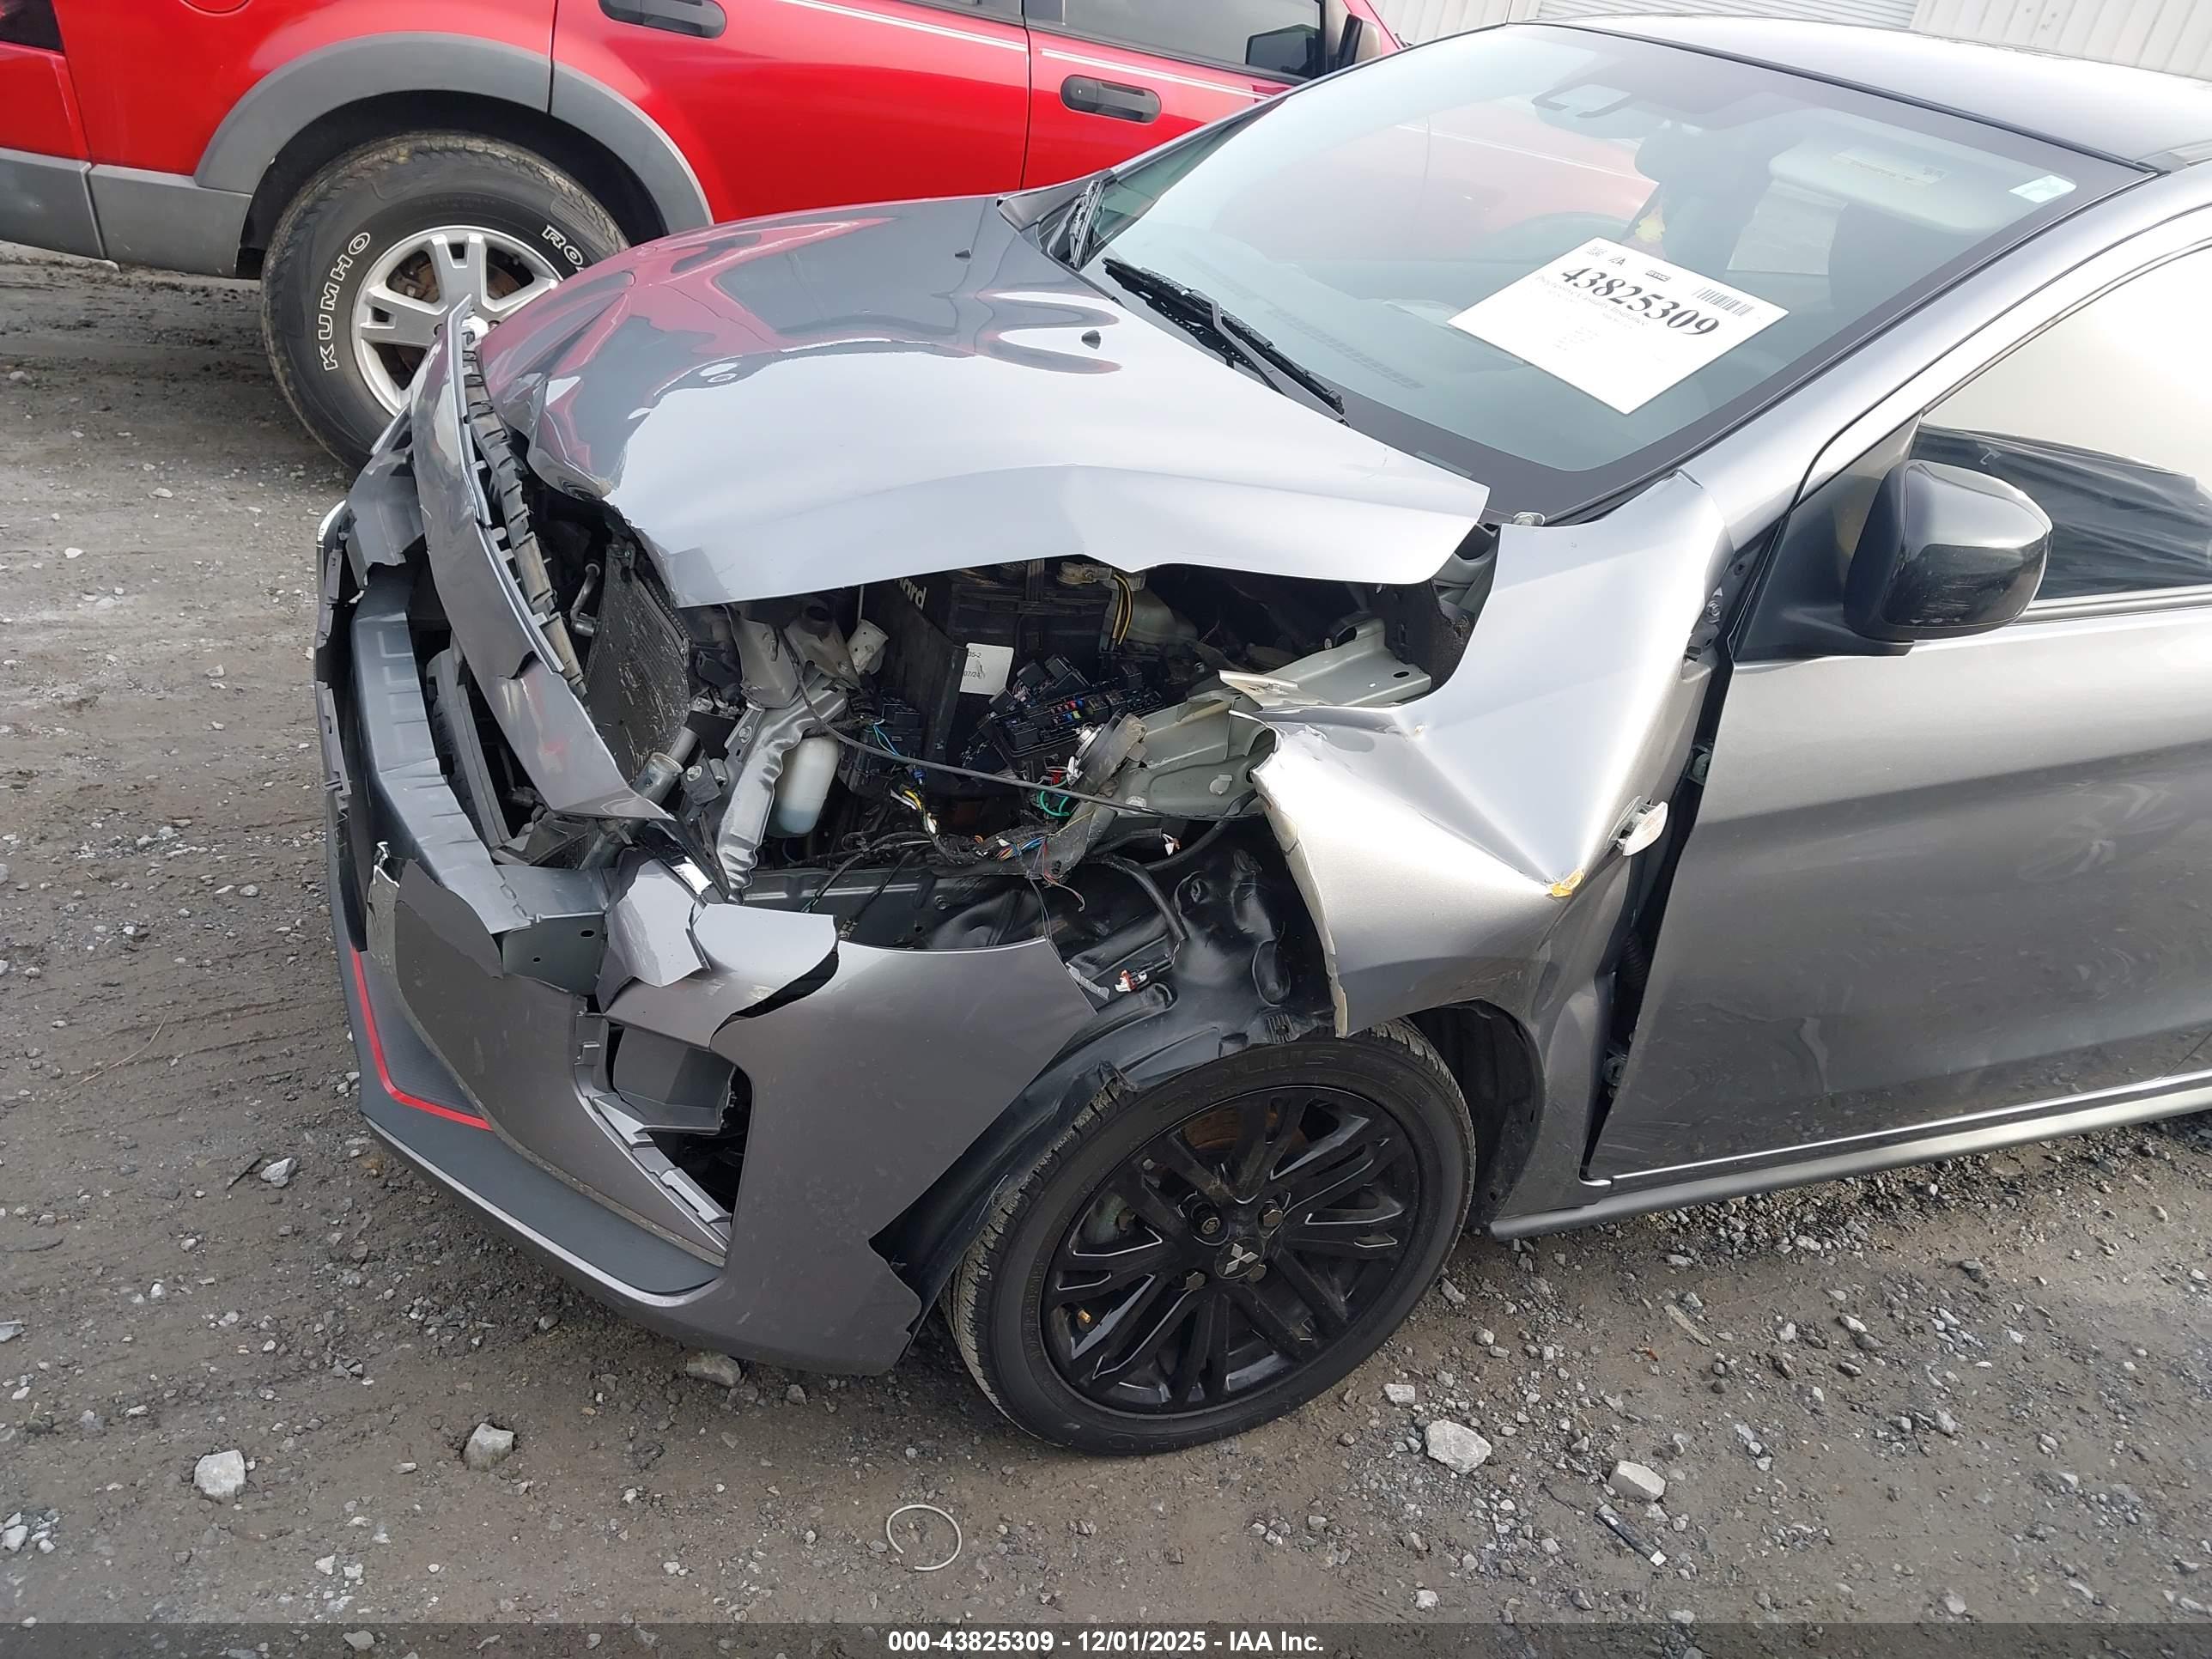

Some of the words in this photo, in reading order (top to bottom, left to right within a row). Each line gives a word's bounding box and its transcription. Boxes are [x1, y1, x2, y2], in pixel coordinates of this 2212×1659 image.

[542, 224, 584, 275] RO
[317, 232, 371, 372] KUMHO
[1560, 267, 1719, 336] 43825309
